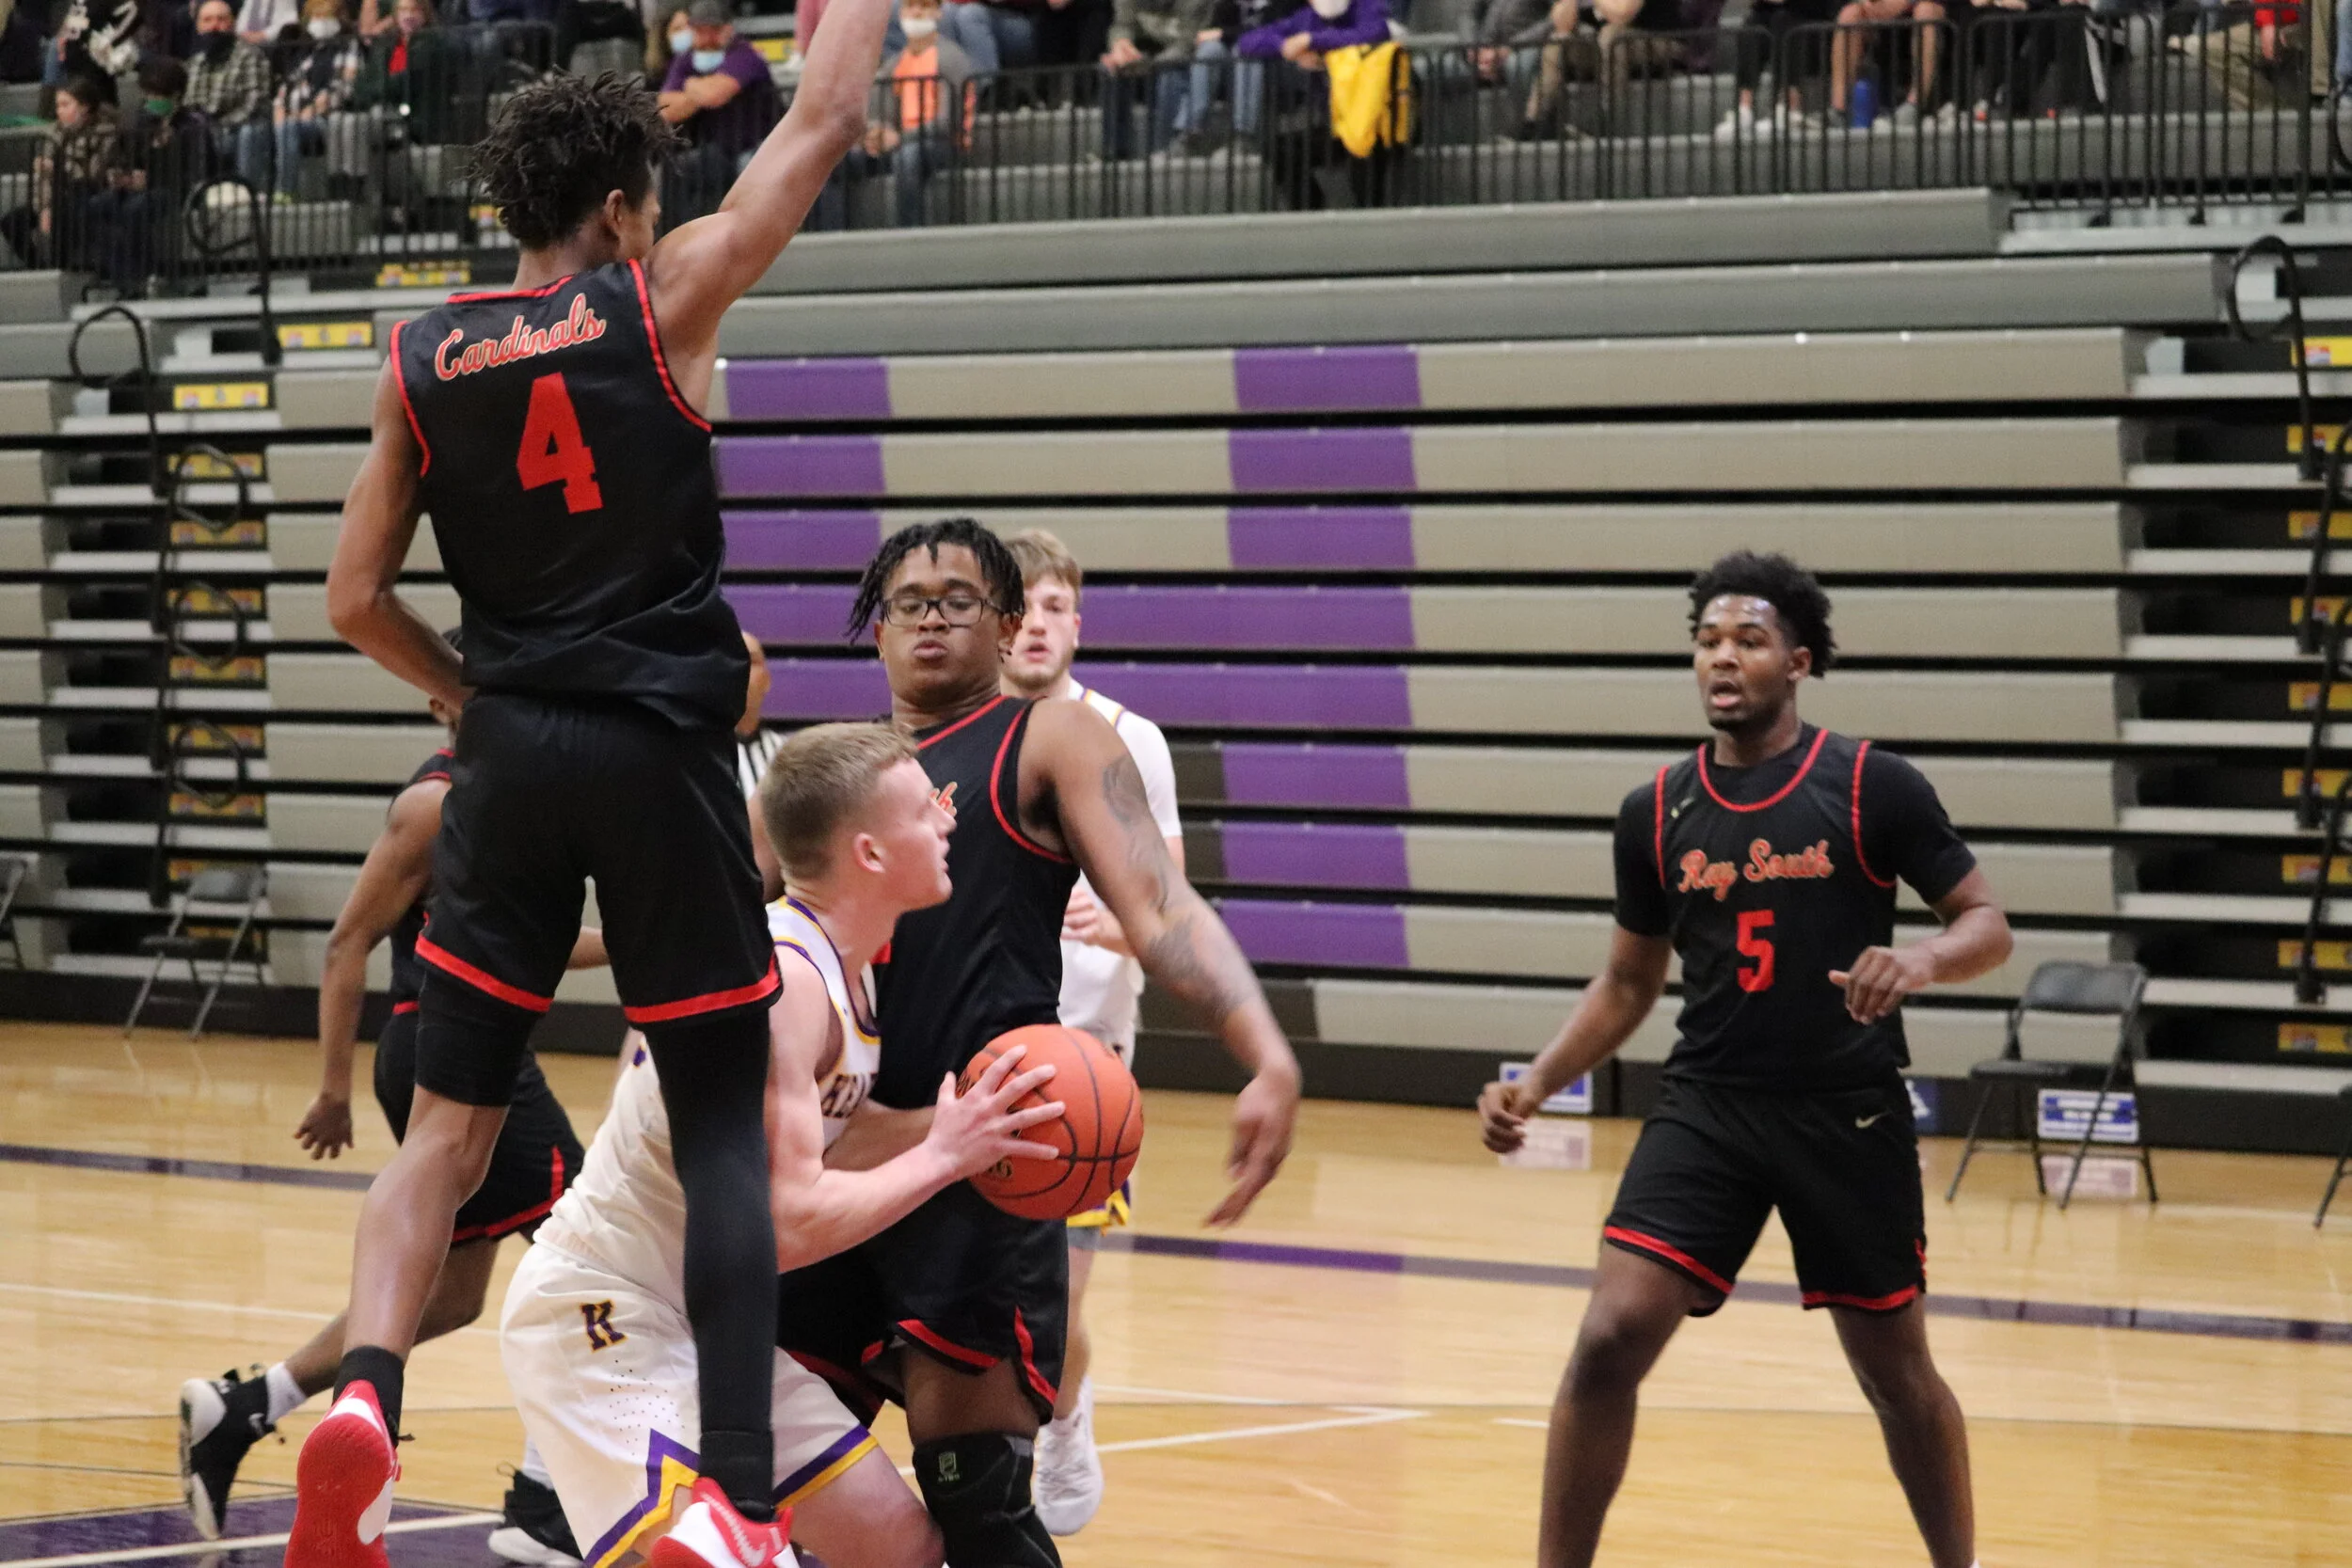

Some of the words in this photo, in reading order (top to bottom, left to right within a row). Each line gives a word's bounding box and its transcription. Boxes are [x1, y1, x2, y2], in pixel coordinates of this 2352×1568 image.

[435, 293, 607, 381] Cardinals
[516, 372, 604, 515] 4
[1742, 838, 1835, 882] South
[1736, 909, 1775, 993] 5
[580, 1299, 628, 1353] K
